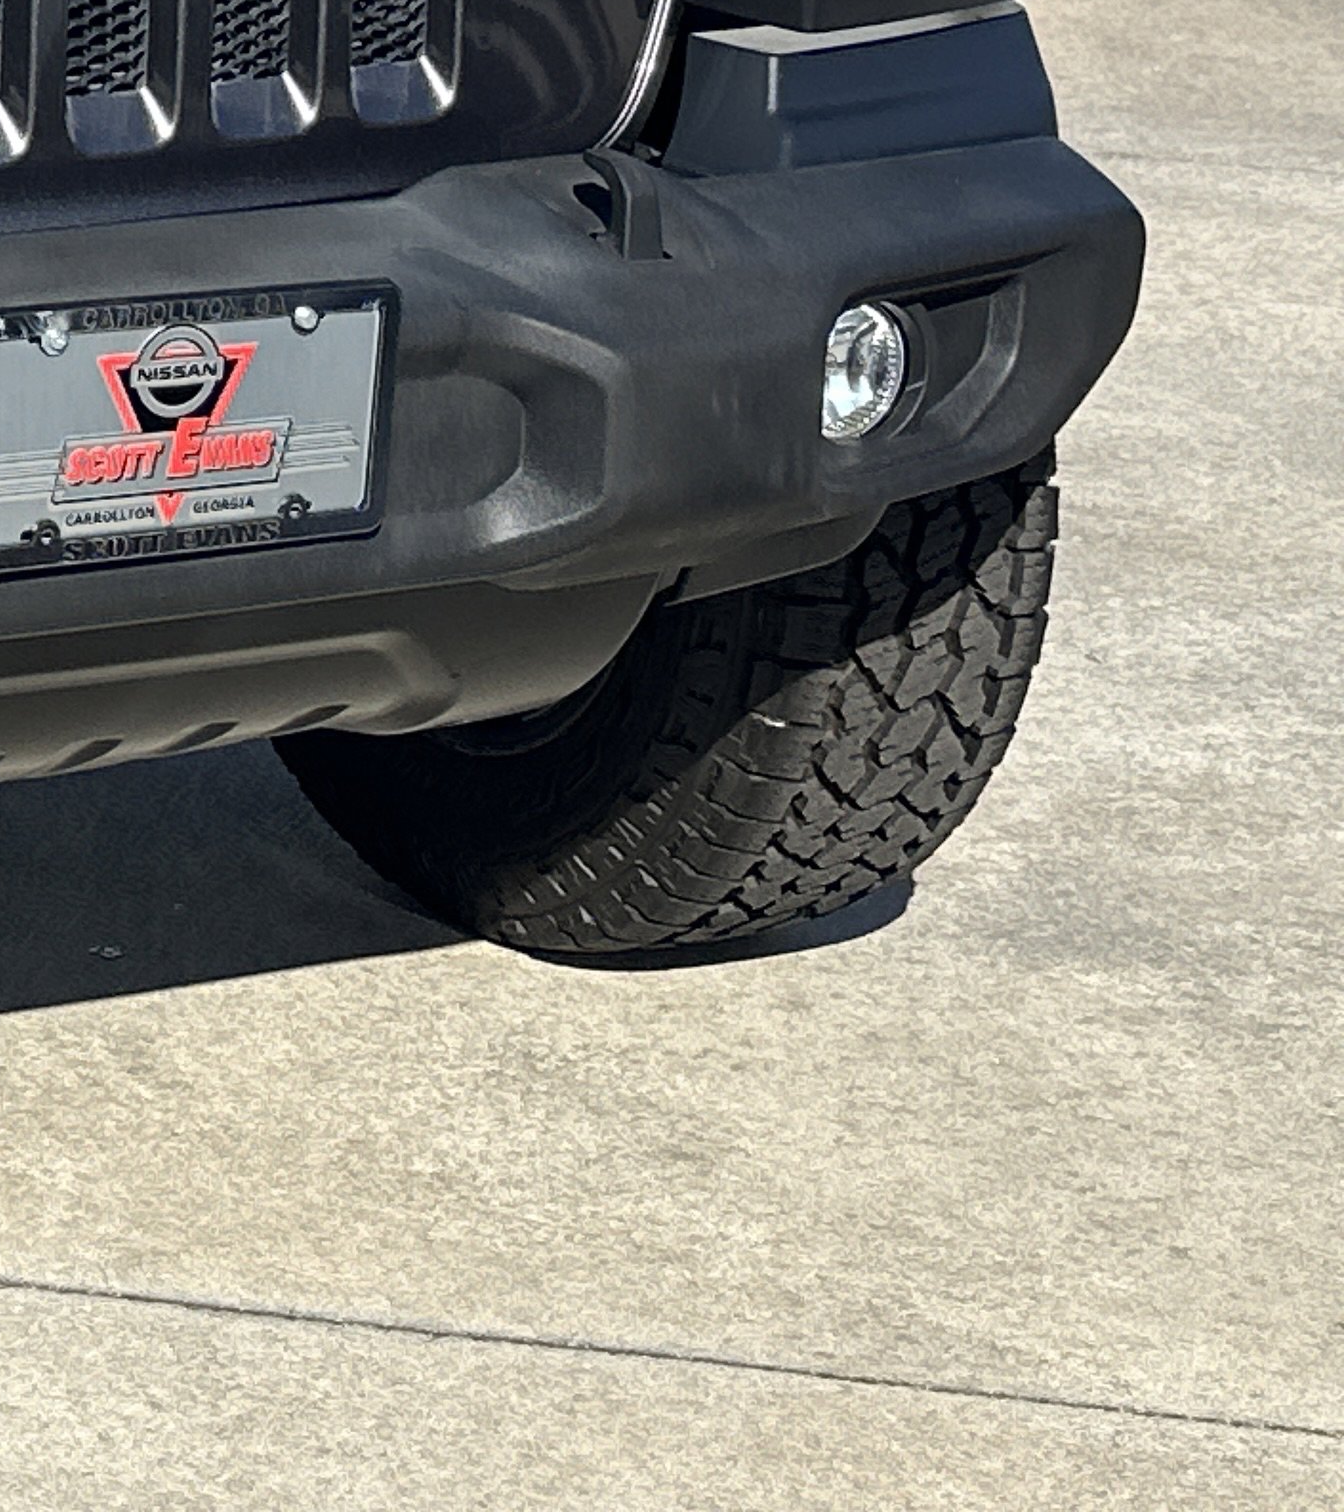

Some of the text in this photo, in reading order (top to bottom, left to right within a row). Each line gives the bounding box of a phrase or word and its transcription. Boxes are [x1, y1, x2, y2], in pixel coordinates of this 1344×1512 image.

[137, 361, 218, 383] NISSAN
[64, 441, 164, 486] SCOTT
[65, 496, 255, 527] CARROLLTON GEORGIA
[63, 519, 282, 562] SCOTT EVANS
